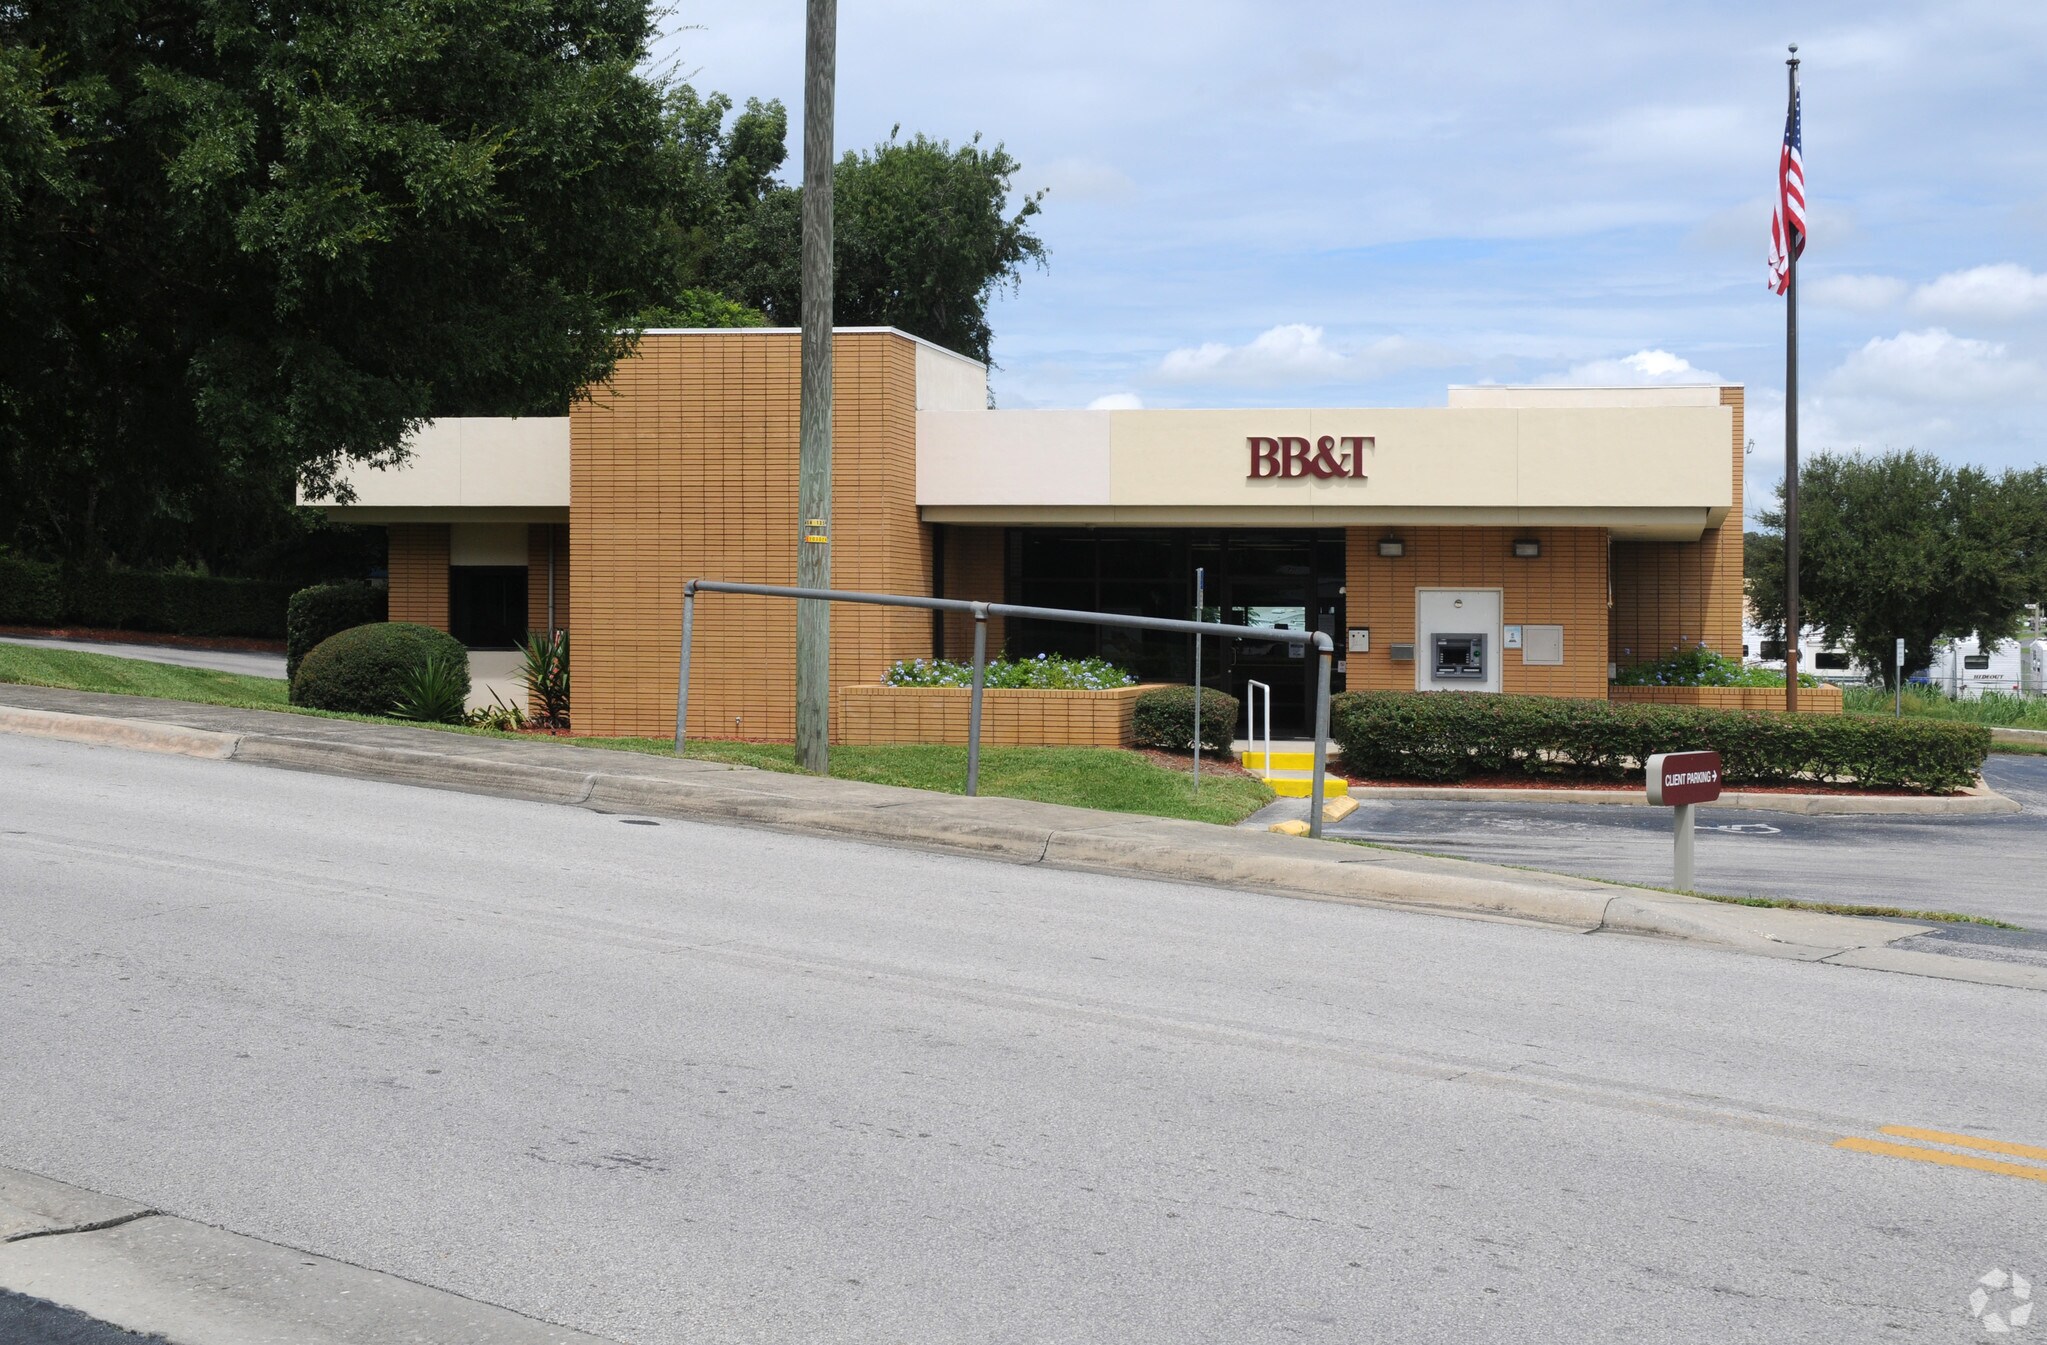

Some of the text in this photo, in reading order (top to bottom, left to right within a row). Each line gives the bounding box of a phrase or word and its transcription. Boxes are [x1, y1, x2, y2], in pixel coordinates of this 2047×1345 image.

[1246, 435, 1376, 480] BB&T
[1665, 770, 1711, 787] CLIENT PARKING
